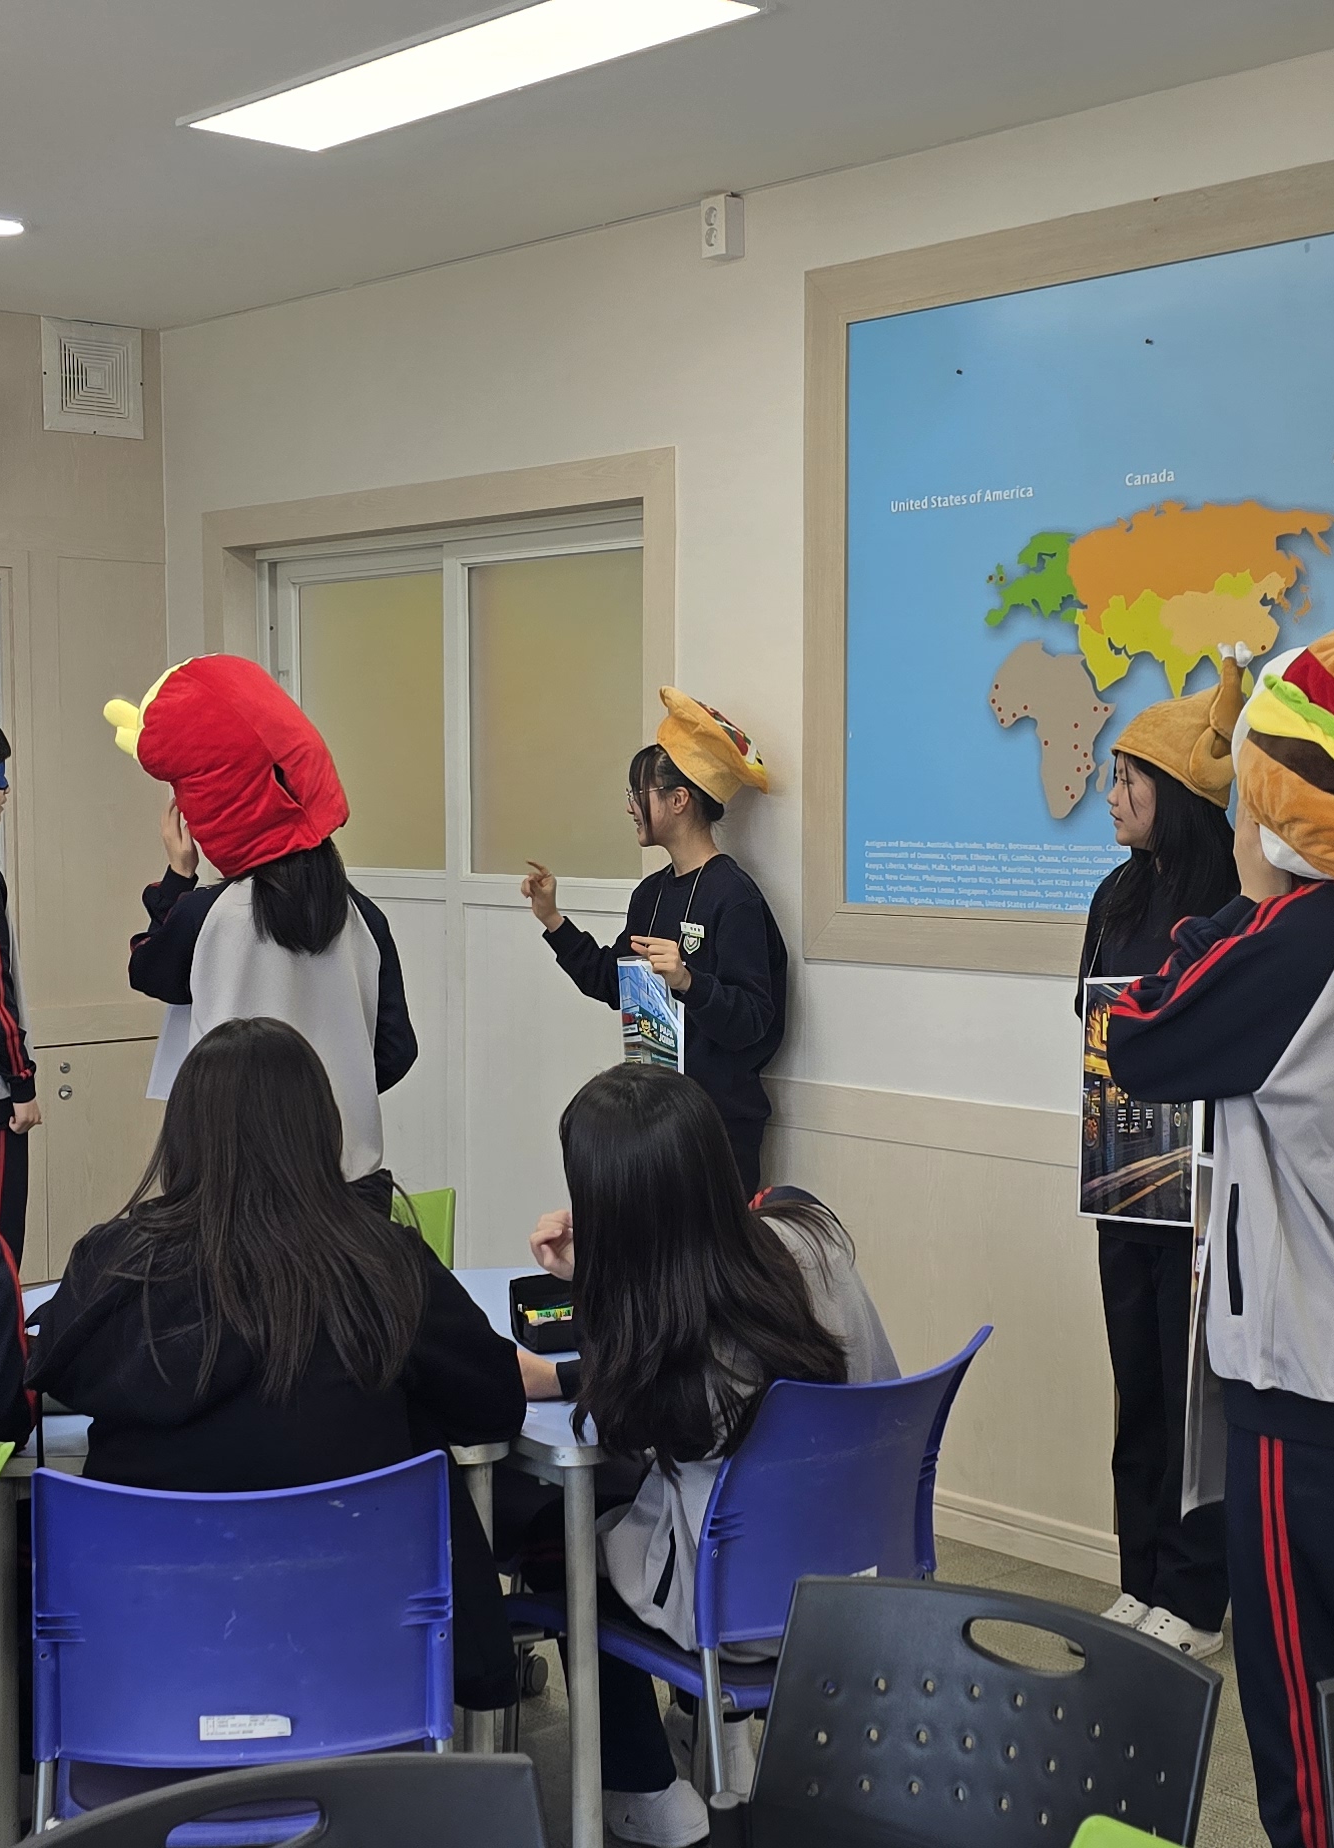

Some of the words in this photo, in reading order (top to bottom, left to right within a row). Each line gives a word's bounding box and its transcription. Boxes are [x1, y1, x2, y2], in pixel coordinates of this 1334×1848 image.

[1125, 468, 1175, 487] Canada
[890, 496, 928, 512] United
[931, 494, 967, 508] States
[969, 489, 983, 504] of
[984, 485, 1034, 502] America
